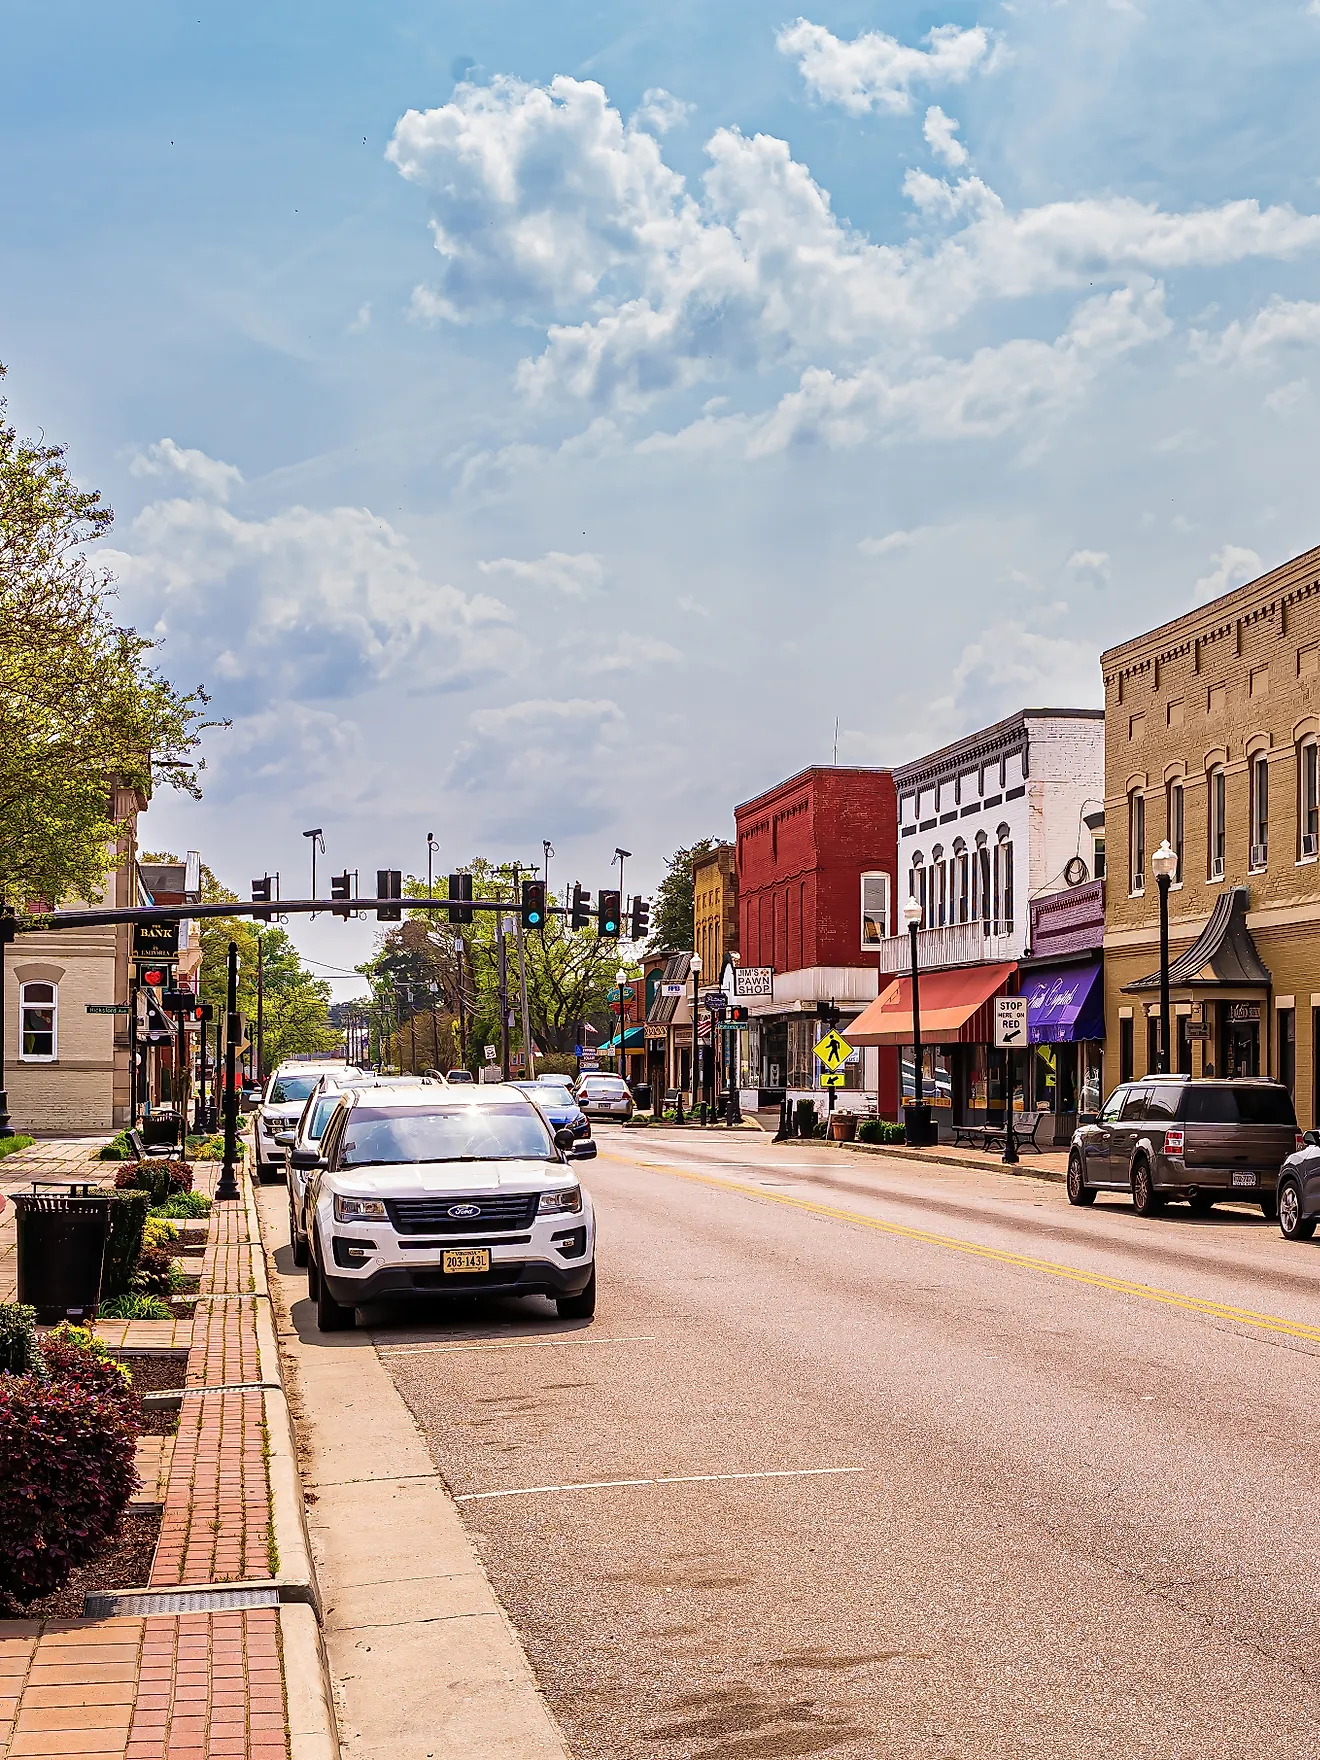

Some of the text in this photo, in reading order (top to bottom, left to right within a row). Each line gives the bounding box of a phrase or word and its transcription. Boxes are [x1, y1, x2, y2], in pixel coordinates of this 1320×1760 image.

[140, 928, 173, 938] BANK
[737, 968, 760, 977] JIM'S
[737, 976, 770, 986] PAWN
[738, 984, 771, 994] SHOP
[1000, 1001, 1023, 1011] STOP
[1002, 1020, 1020, 1029] RED
[455, 1207, 474, 1215] Ford
[446, 1255, 487, 1268] 203-143L
